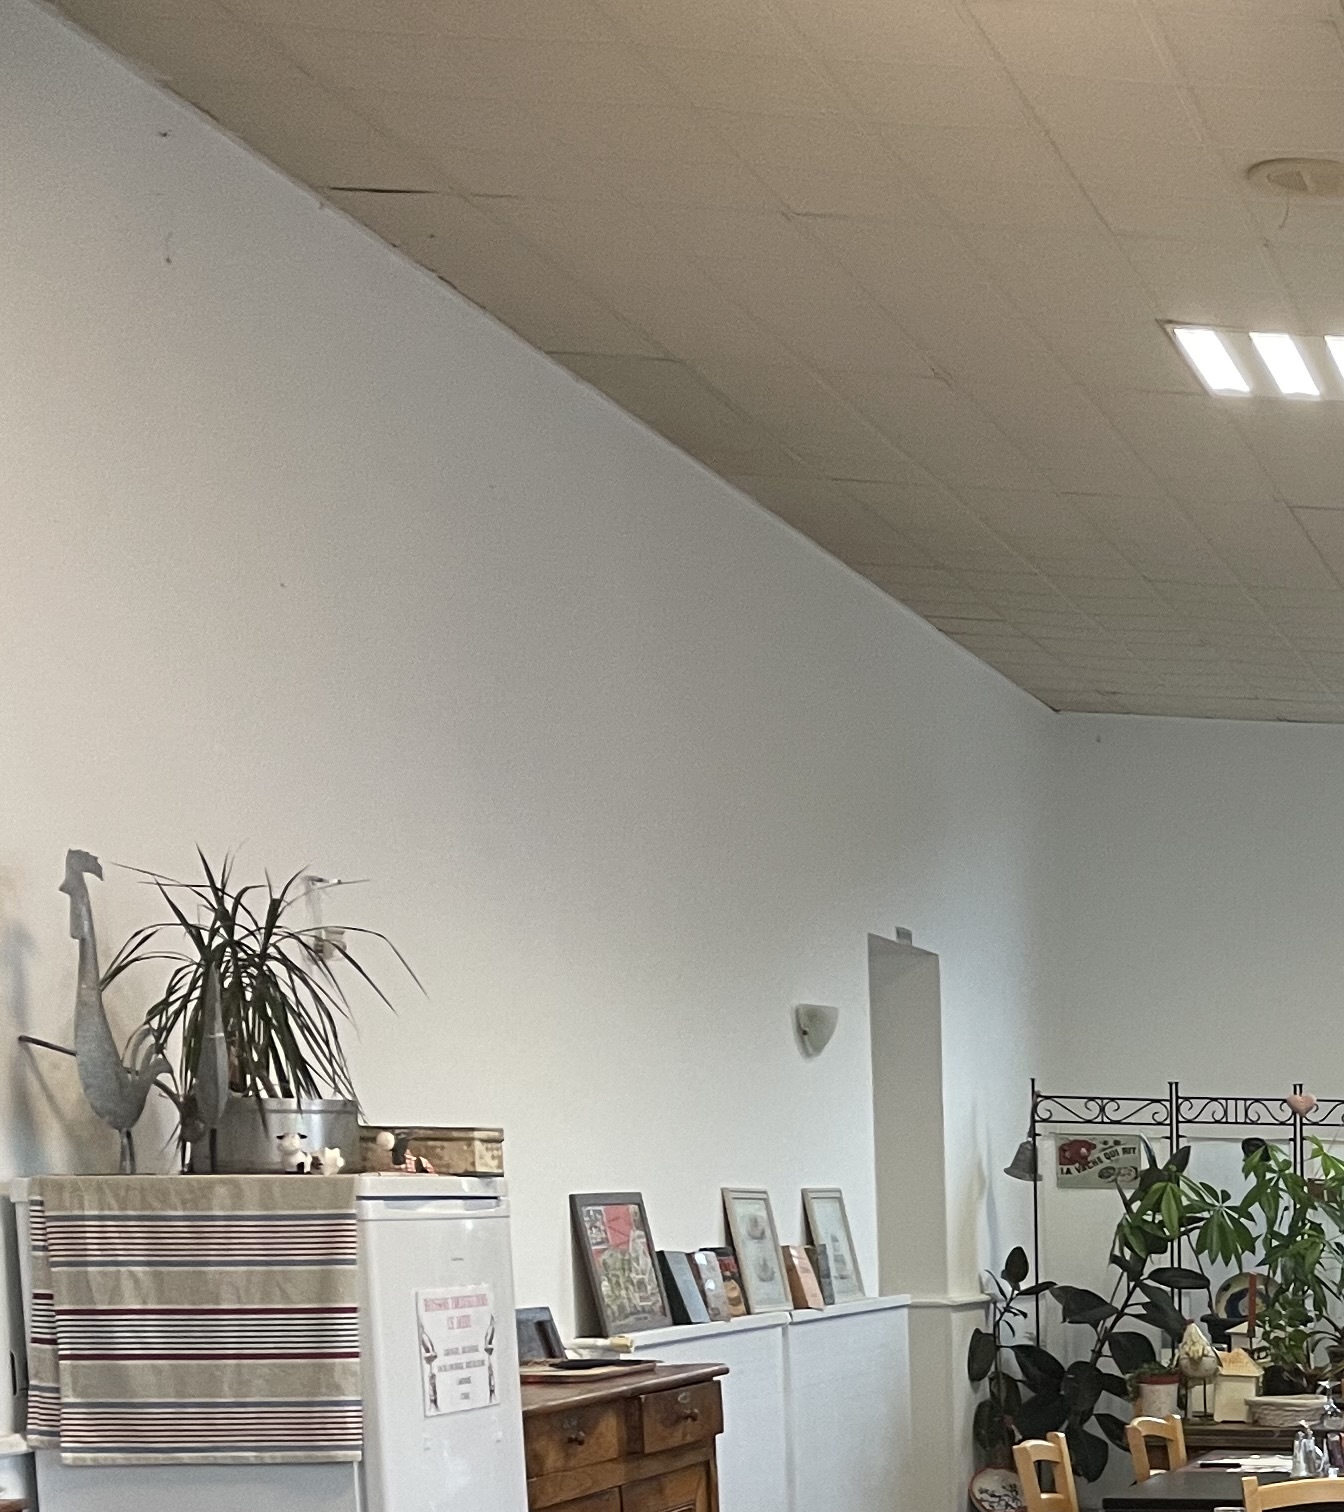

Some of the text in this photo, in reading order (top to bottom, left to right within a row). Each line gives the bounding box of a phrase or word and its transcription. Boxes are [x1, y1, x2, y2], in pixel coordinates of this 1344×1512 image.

[1060, 1146, 1137, 1175] LA VACHE QUI RIT
